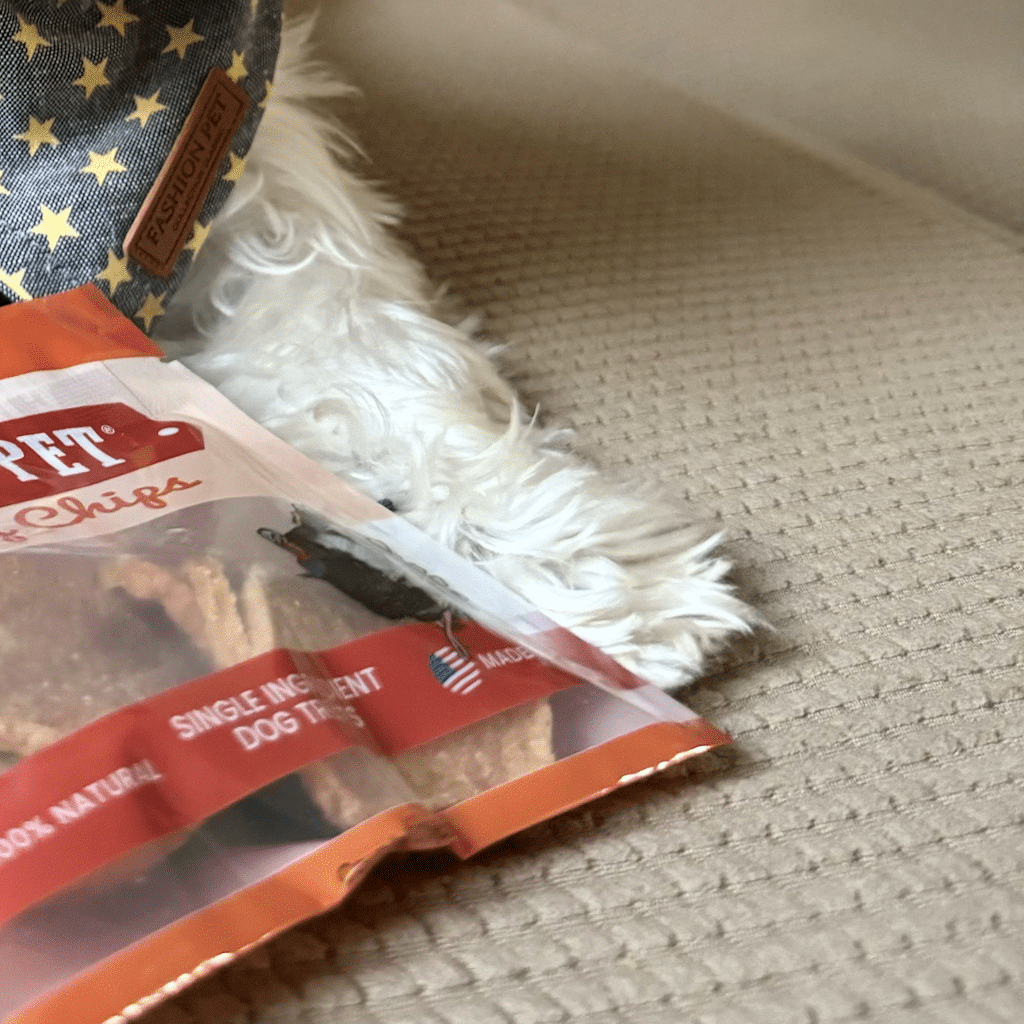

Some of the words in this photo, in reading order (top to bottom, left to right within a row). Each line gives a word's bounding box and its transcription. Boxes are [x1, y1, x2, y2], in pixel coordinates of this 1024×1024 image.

[146, 139, 205, 245] FASHION
[200, 92, 228, 142] PET
[14, 477, 203, 528] Chips
[169, 689, 268, 740] SINGLE
[231, 710, 301, 751] DOG
